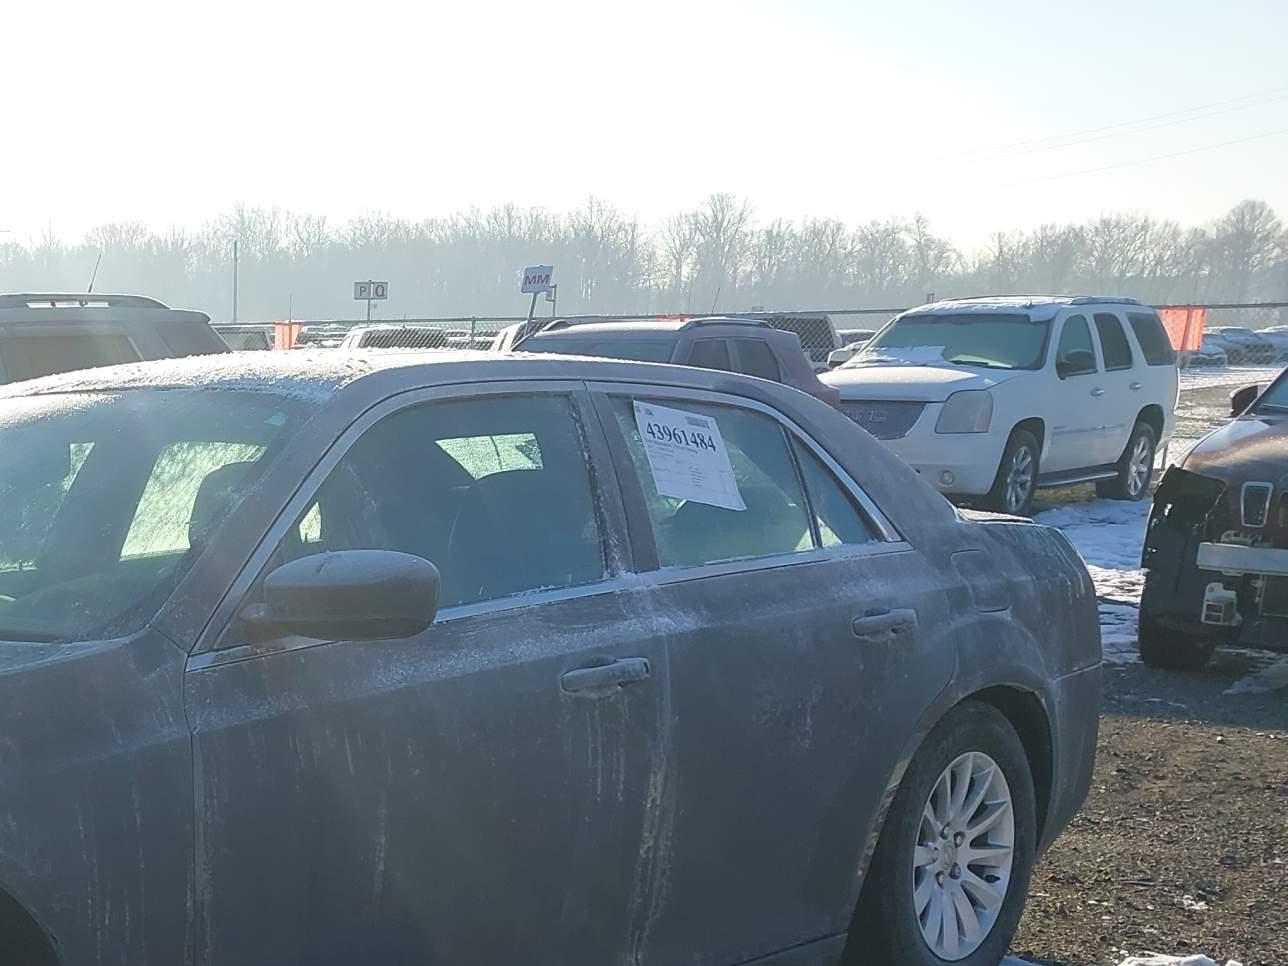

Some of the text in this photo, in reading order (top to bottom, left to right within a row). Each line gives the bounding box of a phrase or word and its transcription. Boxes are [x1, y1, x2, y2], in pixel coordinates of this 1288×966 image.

[524, 273, 551, 286] MM
[359, 285, 367, 297] P
[646, 421, 717, 453] 43961484
